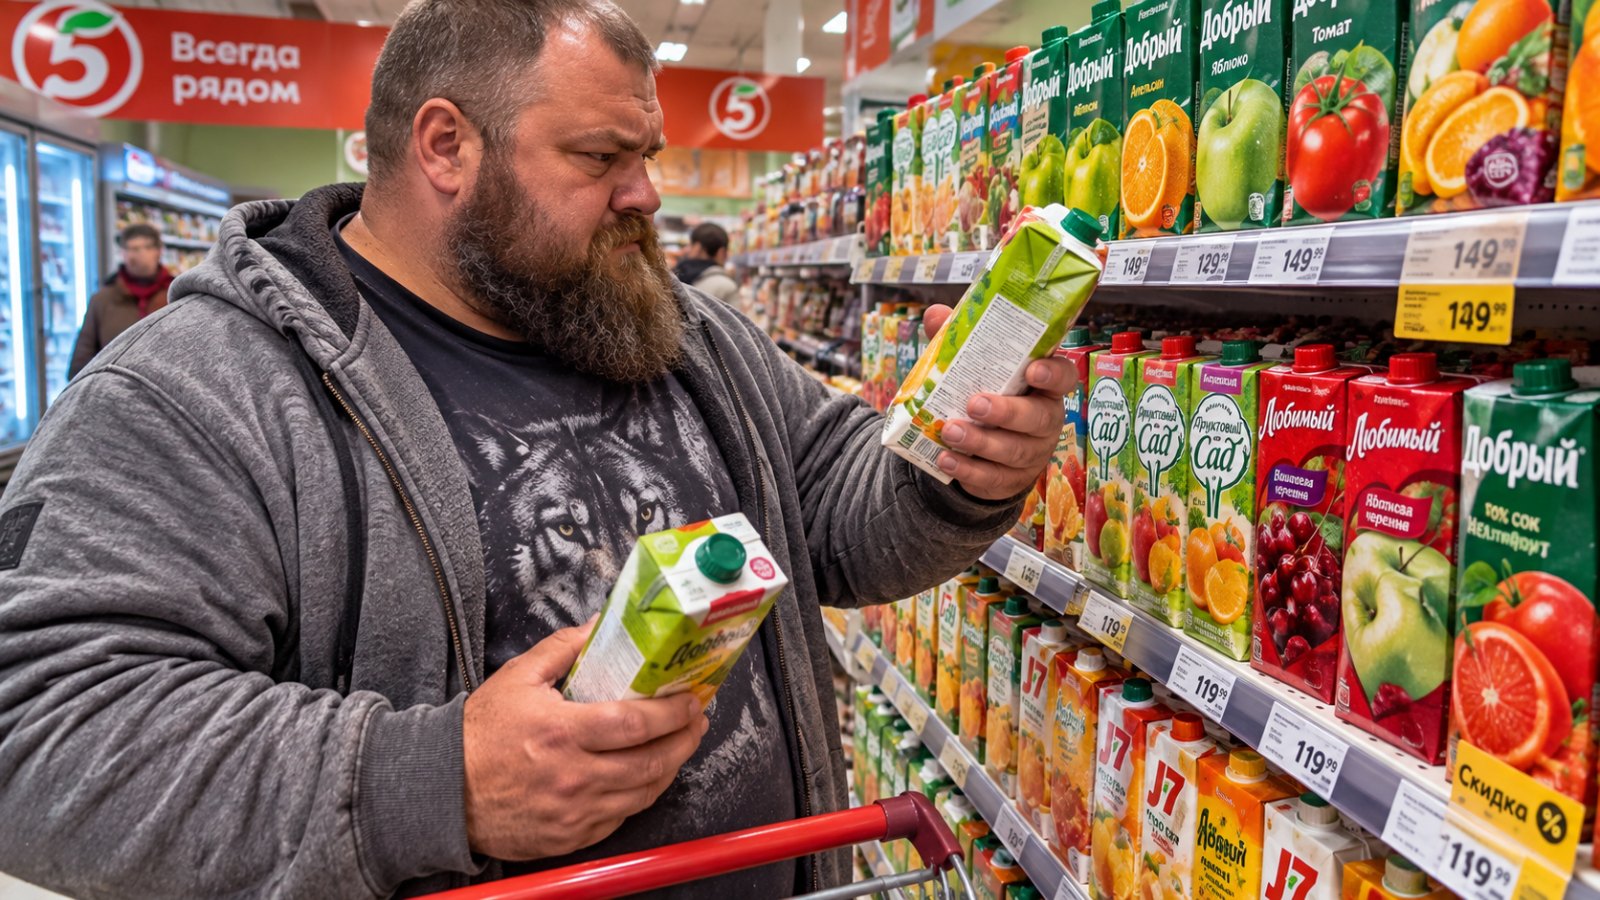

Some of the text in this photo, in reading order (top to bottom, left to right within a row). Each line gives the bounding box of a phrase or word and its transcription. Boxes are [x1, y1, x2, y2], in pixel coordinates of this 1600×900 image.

[171, 32, 299, 69] Всегда
[1123, 18, 1183, 77] Добрый
[1312, 19, 1352, 44] Томат
[42, 31, 109, 99] 5
[1066, 49, 1114, 98] Добрый
[173, 74, 300, 104] рядом
[722, 86, 757, 131] 5
[1020, 72, 1061, 113] Добрый
[1123, 256, 1142, 275] 149
[1198, 252, 1220, 275] 129
[1283, 247, 1313, 273] 149
[1453, 238, 1499, 270] 149
[1493, 303, 1507, 316] 99
[1259, 397, 1335, 441] Любимый
[1346, 412, 1442, 461] Любимый
[1139, 423, 1179, 456] Сад
[1194, 435, 1244, 472] Сад
[1461, 425, 1579, 489] Добрый
[1022, 655, 1048, 699] J7
[1195, 675, 1219, 703] 119
[1099, 720, 1132, 771] J7
[1295, 740, 1338, 775] 119 99
[1147, 760, 1186, 817] J7
[1459, 764, 1529, 823] Скидка
[1264, 848, 1319, 900] J7
[1495, 867, 1511, 886] 99
